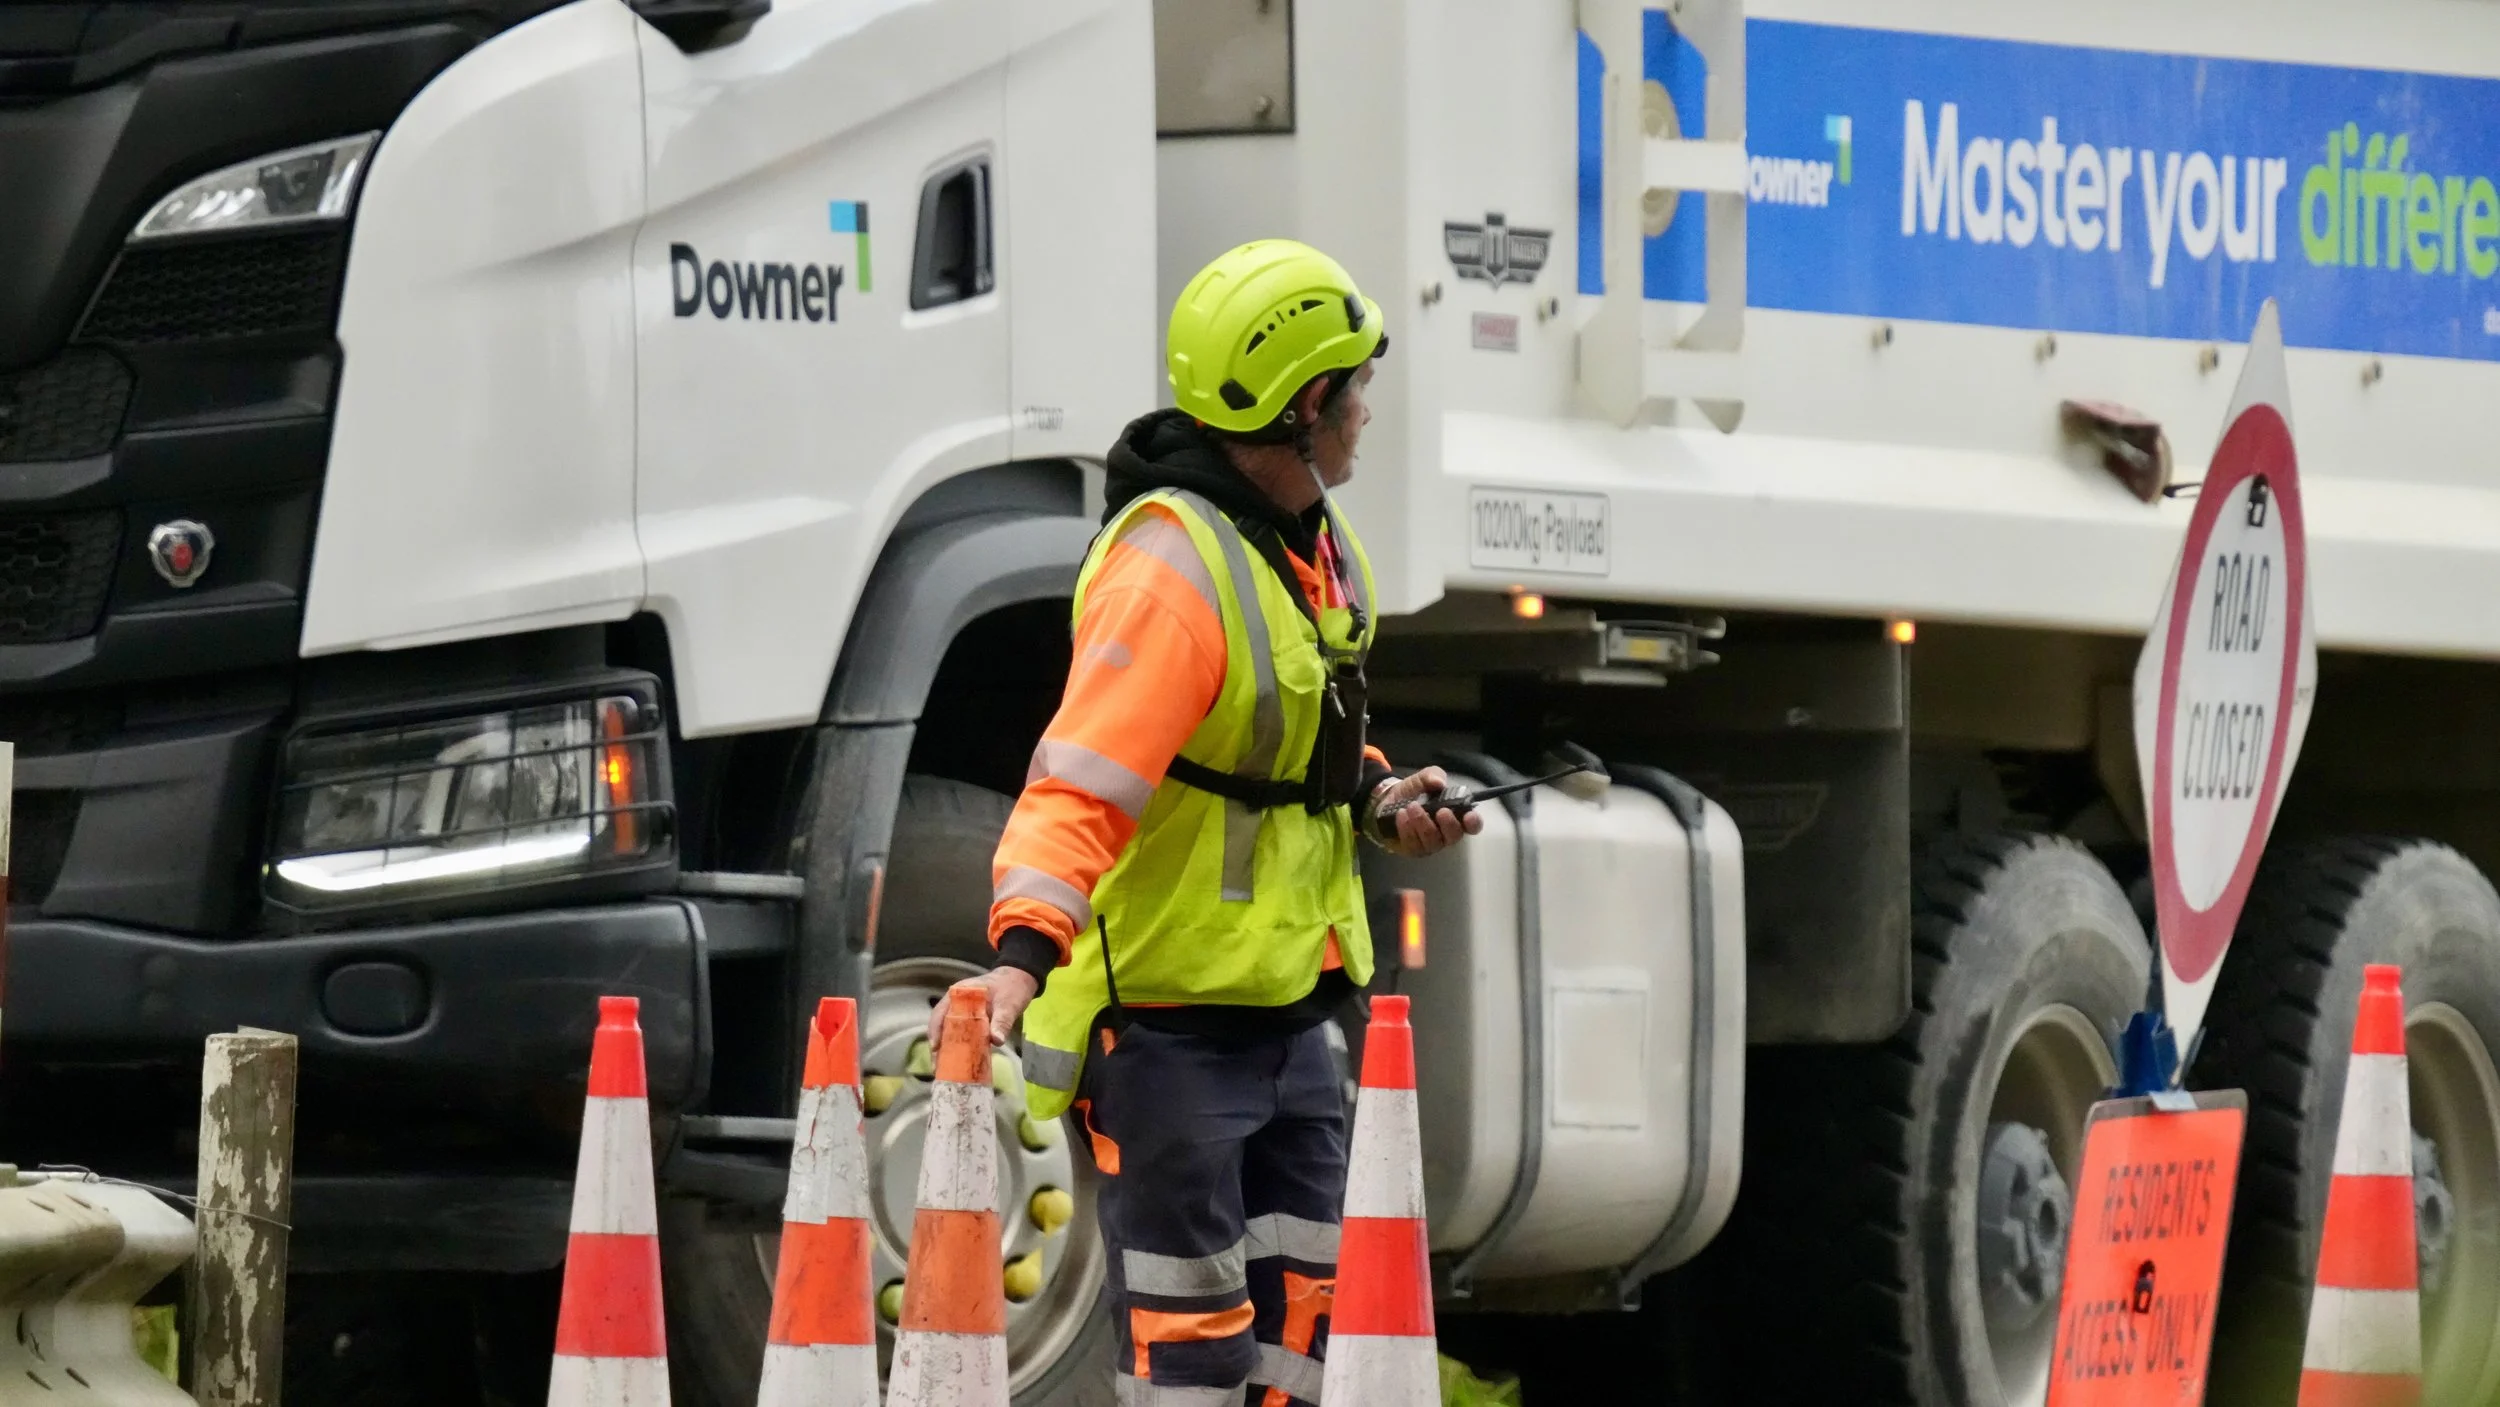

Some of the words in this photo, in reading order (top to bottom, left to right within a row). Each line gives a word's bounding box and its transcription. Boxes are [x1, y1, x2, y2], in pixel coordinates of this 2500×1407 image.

[1746, 157, 1833, 207] owner
[1901, 99, 2132, 252] Master
[2140, 148, 2286, 289] your
[670, 242, 844, 323] Downer
[1474, 499, 1541, 565] 10200kg
[1545, 502, 1605, 565] Payload
[2208, 551, 2270, 652] ROAD
[2183, 702, 2264, 800] CLOSED
[2101, 1158, 2216, 1244] RESIDENTS
[2059, 1297, 2139, 1379] ACCESS
[2146, 1291, 2210, 1373] ONLY
